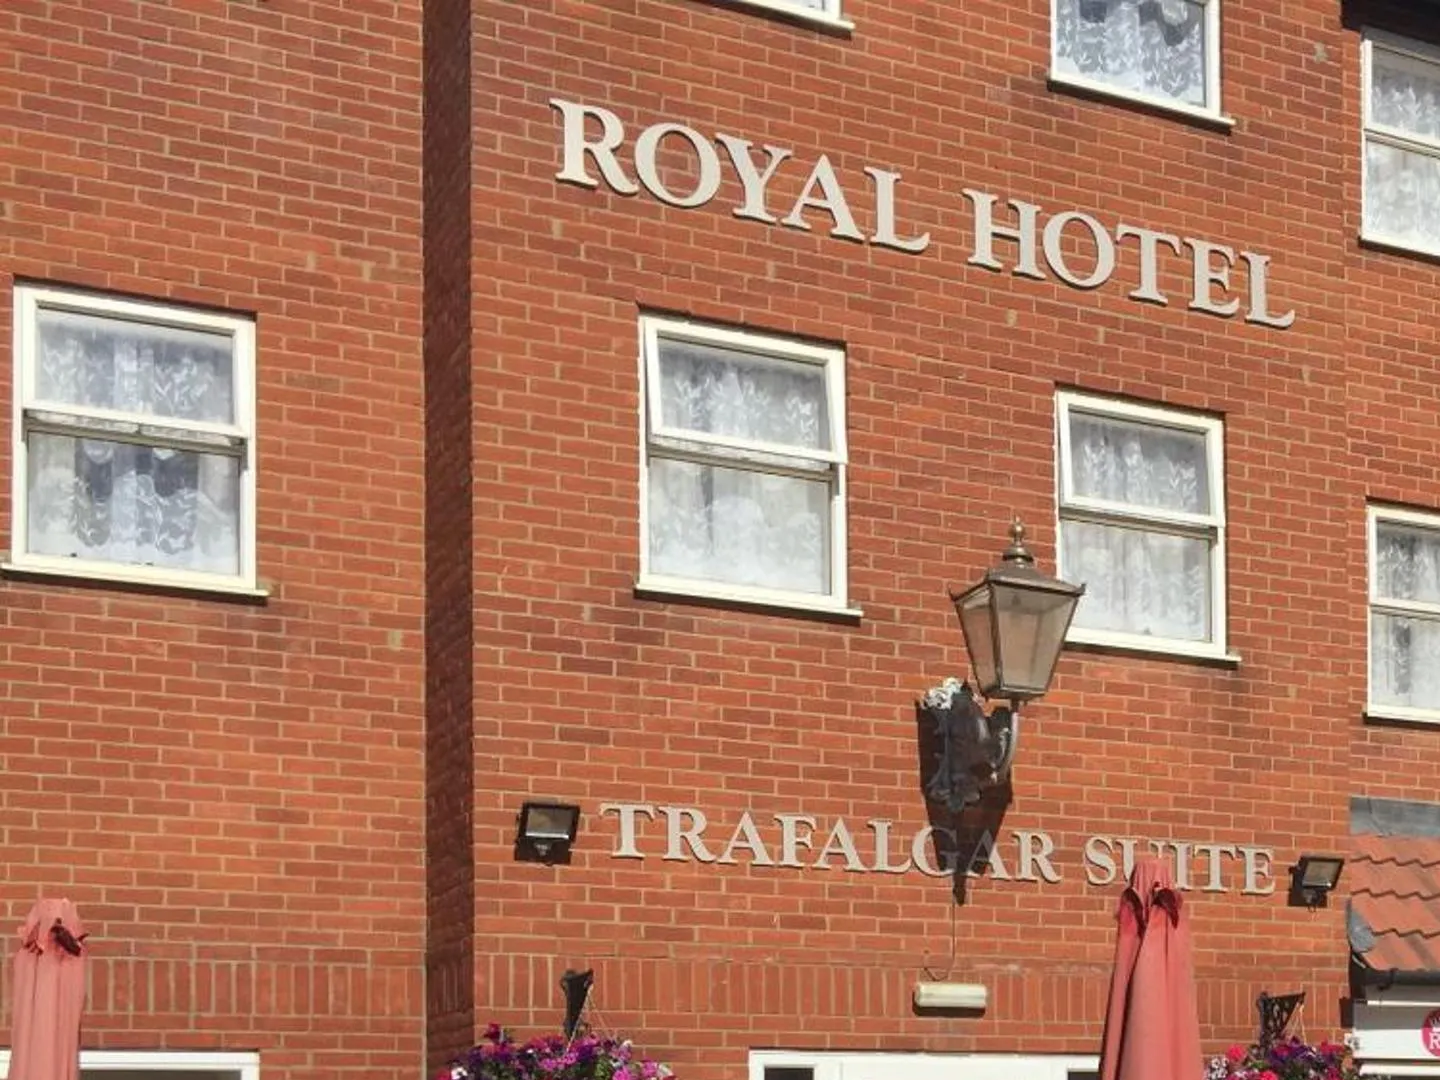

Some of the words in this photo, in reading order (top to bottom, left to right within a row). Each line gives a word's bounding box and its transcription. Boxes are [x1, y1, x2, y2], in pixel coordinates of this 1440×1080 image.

[550, 98, 930, 254] ROYAL
[961, 187, 1296, 328] HOTEL
[601, 803, 1062, 884] TRAFALGAR
